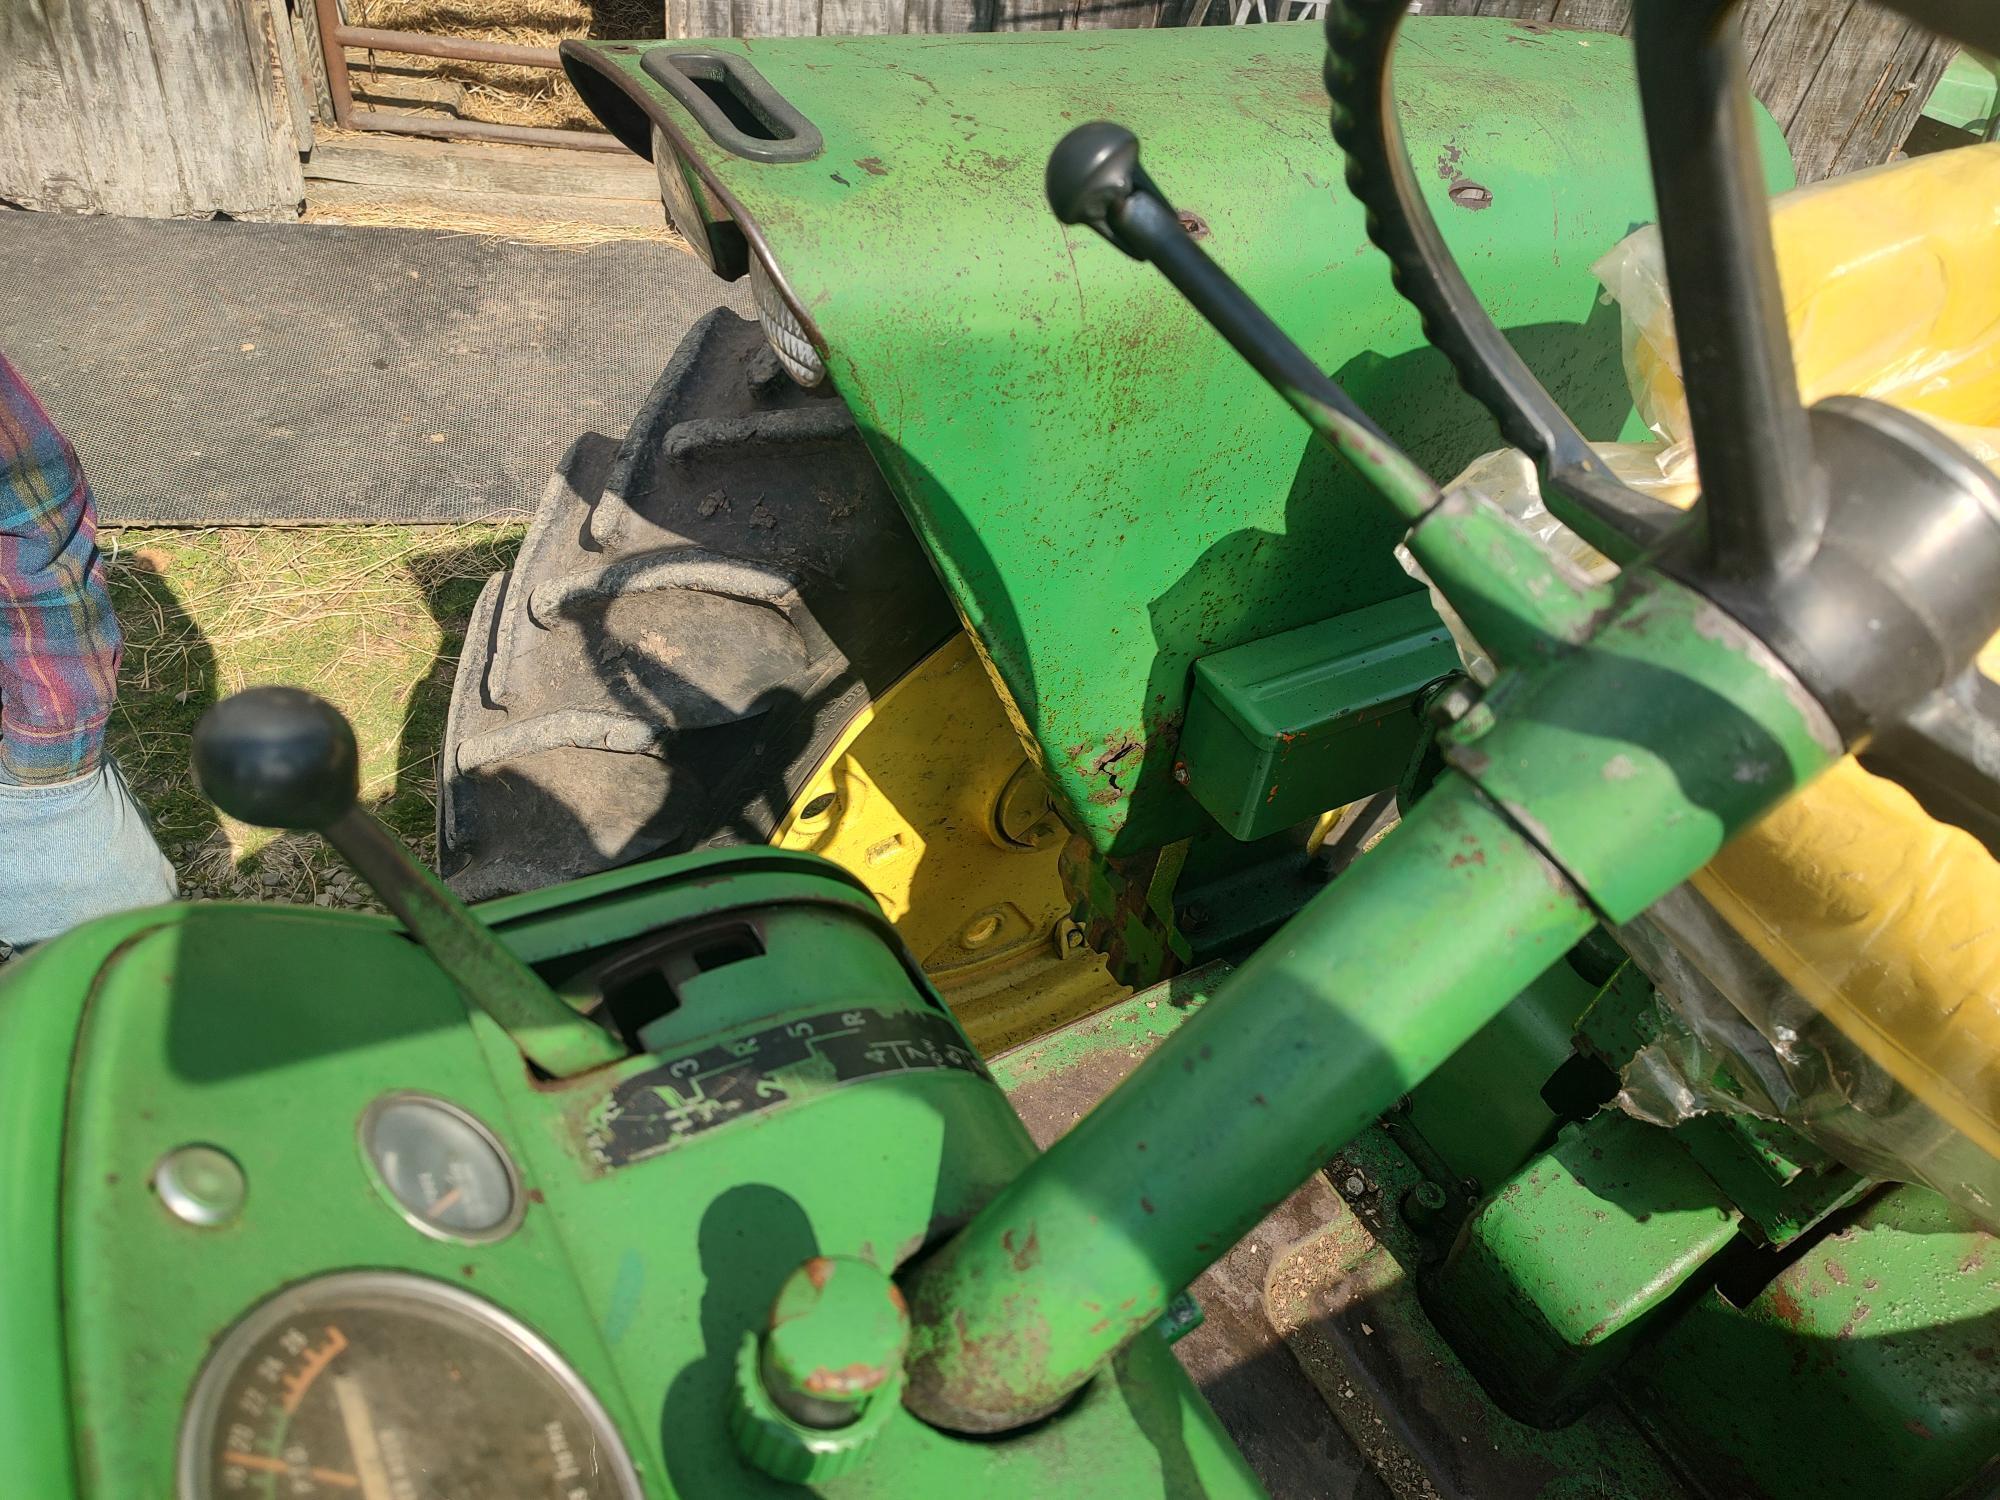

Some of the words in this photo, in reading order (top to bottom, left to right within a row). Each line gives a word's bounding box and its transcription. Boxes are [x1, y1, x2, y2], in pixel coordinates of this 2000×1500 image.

[840, 1011, 867, 1026] R
[785, 1022, 814, 1038] 5
[669, 1058, 700, 1079] 3
